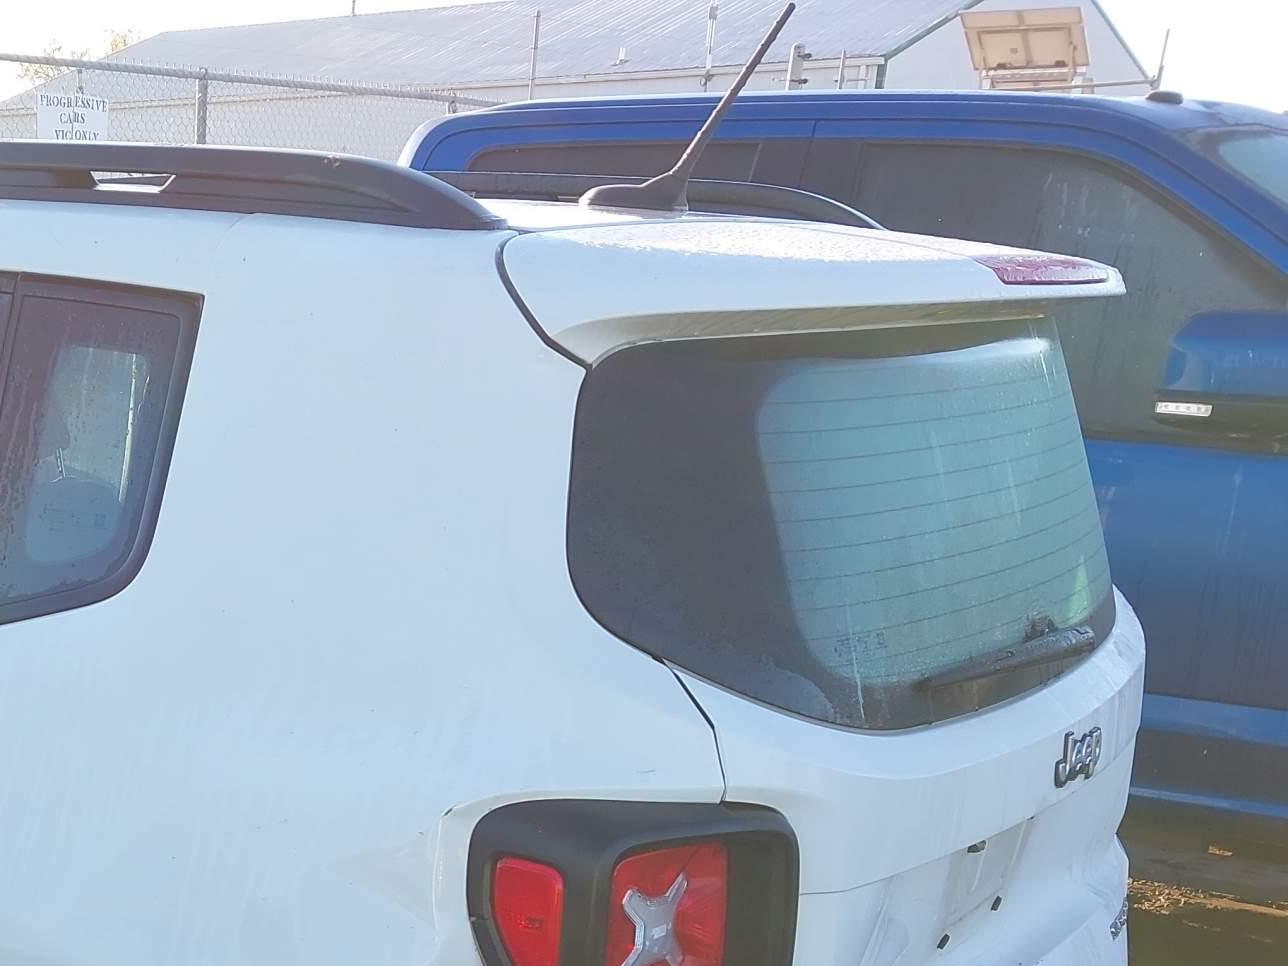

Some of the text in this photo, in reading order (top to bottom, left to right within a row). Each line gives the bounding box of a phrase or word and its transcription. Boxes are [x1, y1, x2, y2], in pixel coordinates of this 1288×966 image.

[39, 94, 108, 113] PROGRESSIVE
[59, 111, 87, 124] CARS
[1053, 726, 1102, 789] Jeep
